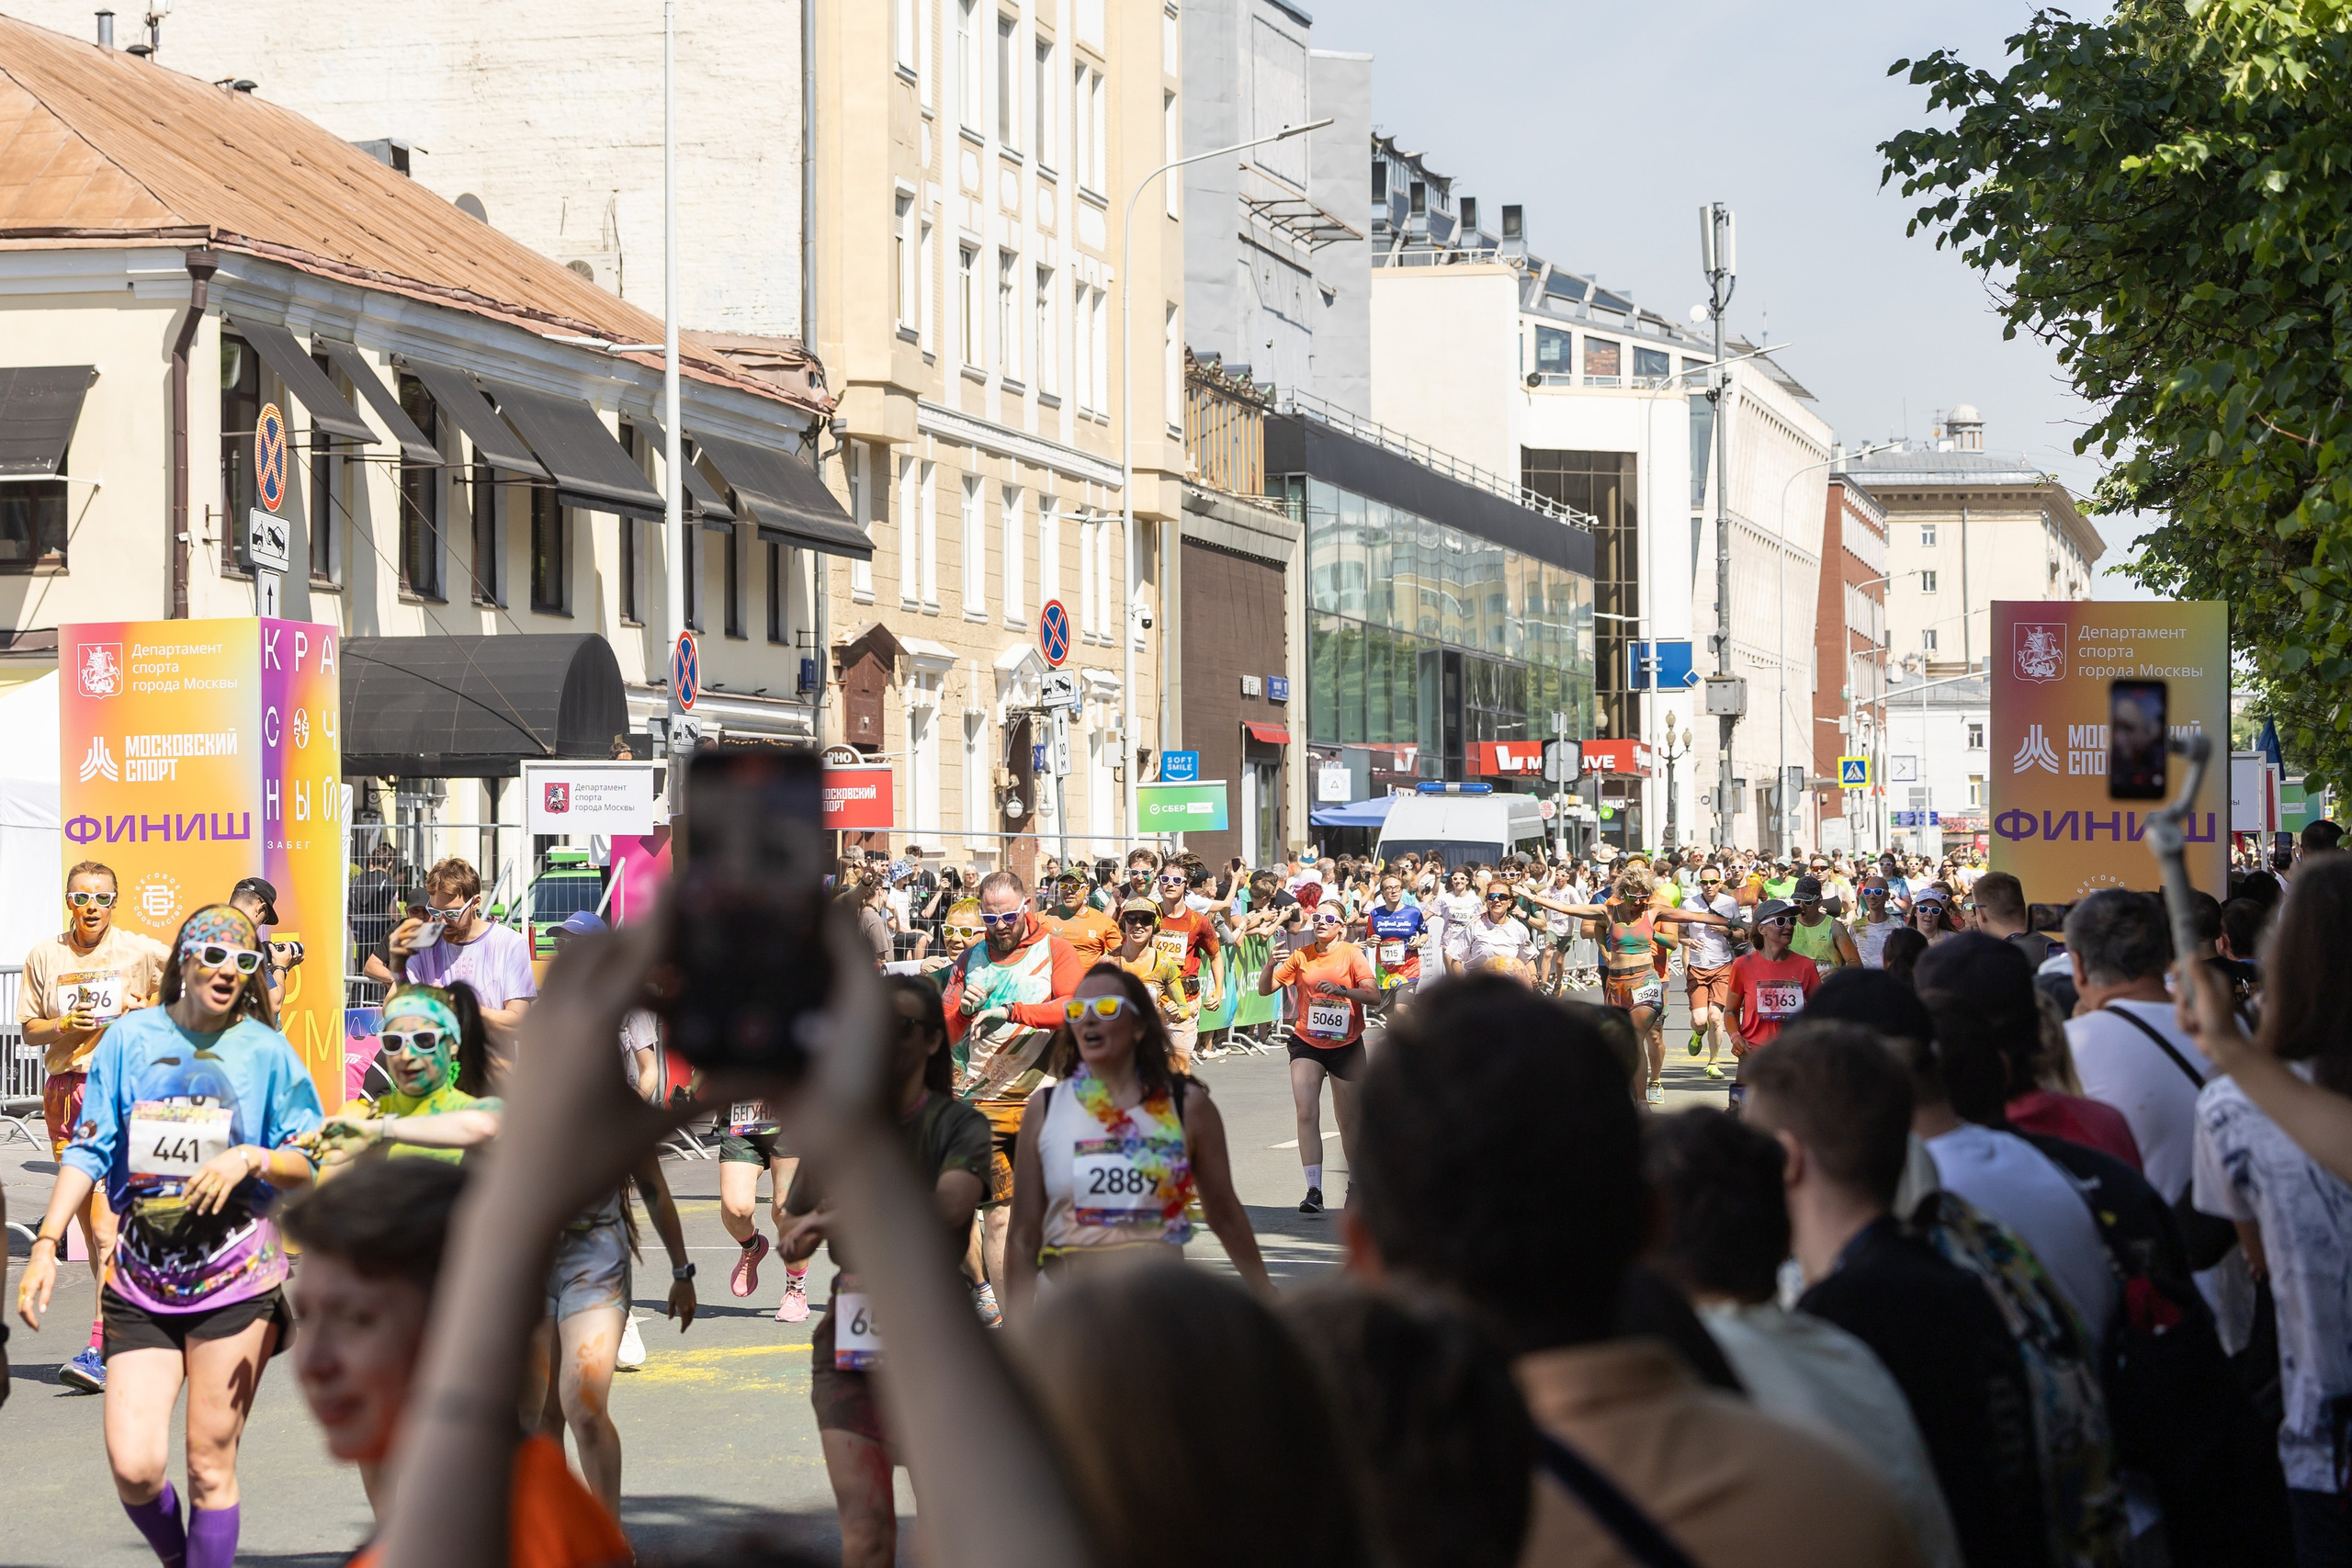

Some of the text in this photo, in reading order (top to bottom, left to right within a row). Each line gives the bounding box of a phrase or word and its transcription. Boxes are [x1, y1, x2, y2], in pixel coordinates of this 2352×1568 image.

[2077, 625, 2187, 642] Департамент
[131, 643, 223, 659] Департамент
[2078, 647, 2134, 661] спорта
[132, 661, 179, 676] спорта
[2078, 663, 2203, 680] города Москвы
[132, 677, 238, 694] города Москвы
[125, 728, 238, 758] МОСКОВСКИЙ
[1059, 743, 1067, 759] 10
[126, 759, 178, 782] СПОРТ
[574, 783, 627, 793] Департамент
[574, 795, 602, 803] спорта
[822, 800, 845, 812] ПОРТ
[574, 805, 603, 813] города
[1162, 805, 1185, 813] СБЕР
[64, 812, 251, 845] ФИНИШ
[266, 840, 311, 850] ЗАБЕГ
[135, 872, 182, 891] БЕГОВОЕ
[2076, 874, 2125, 895] БЕГОВО
[133, 905, 183, 928] СООБЩЕСТВО
[1156, 941, 1182, 953] 4928
[1385, 950, 1398, 958] 715
[67, 990, 112, 1011] 296
[1637, 987, 1659, 1001] 3528
[1764, 994, 1797, 1007] 5163
[1312, 1011, 1343, 1027] 5068
[153, 1136, 199, 1164] 441
[1089, 1167, 1159, 1196] 2889
